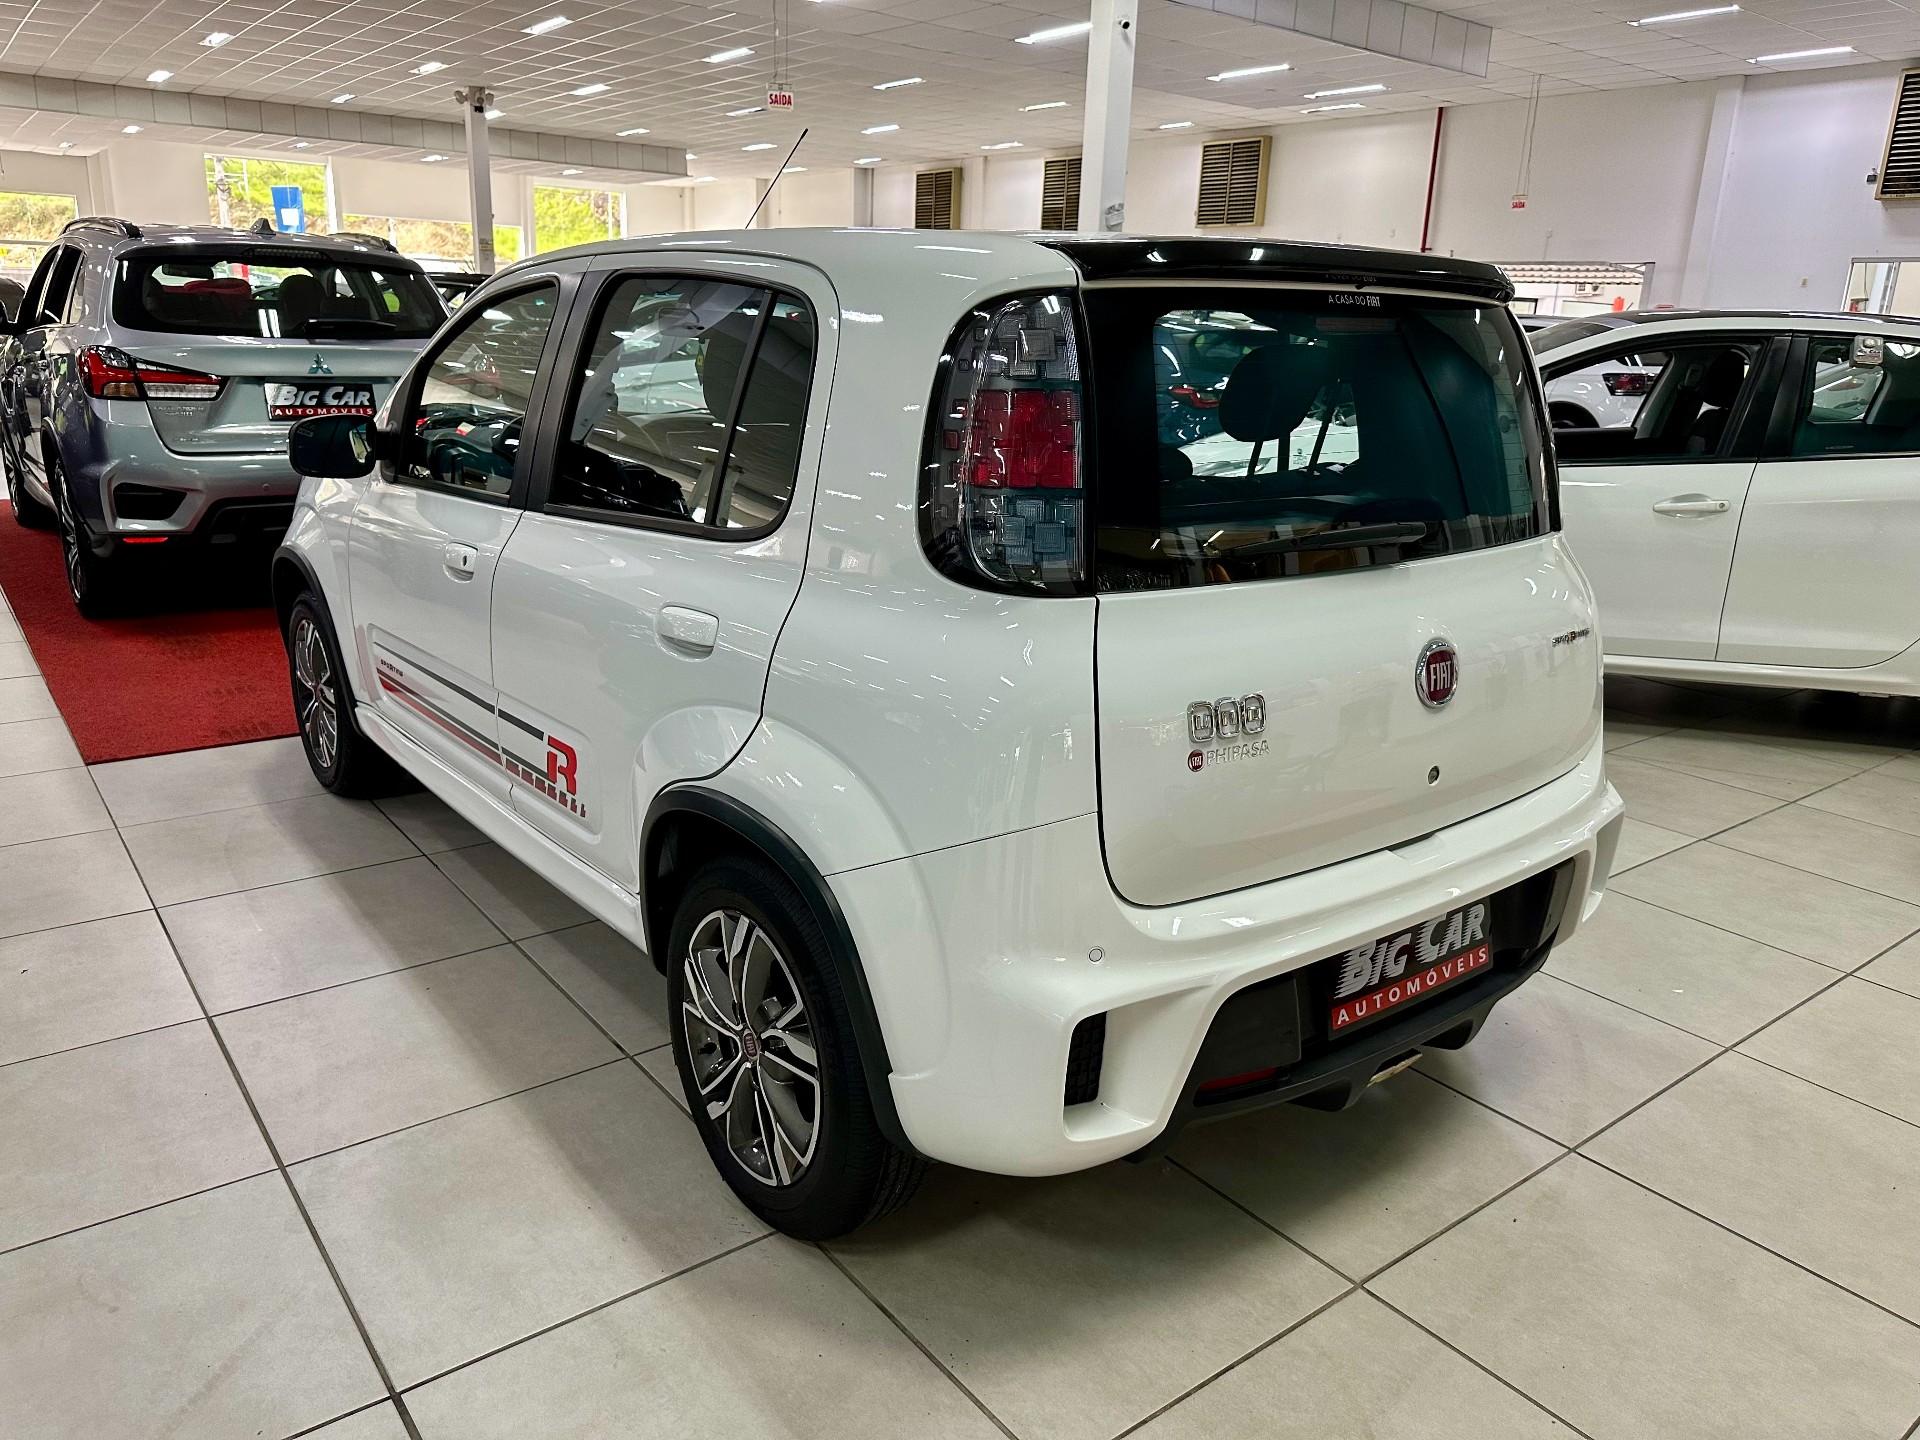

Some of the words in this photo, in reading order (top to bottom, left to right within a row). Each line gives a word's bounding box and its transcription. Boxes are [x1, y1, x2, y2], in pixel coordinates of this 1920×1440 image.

[769, 92, 792, 106] SAÍDA
[1335, 294, 1354, 305] CASA
[1355, 295, 1365, 306] DO
[1366, 295, 1381, 307] FIAT
[274, 407, 373, 416] AUTOMÓVEIS
[1430, 660, 1452, 692] FIAT
[1206, 740, 1270, 766] PHIPASA
[1337, 947, 1487, 1025] AUTOMÓVEIS
